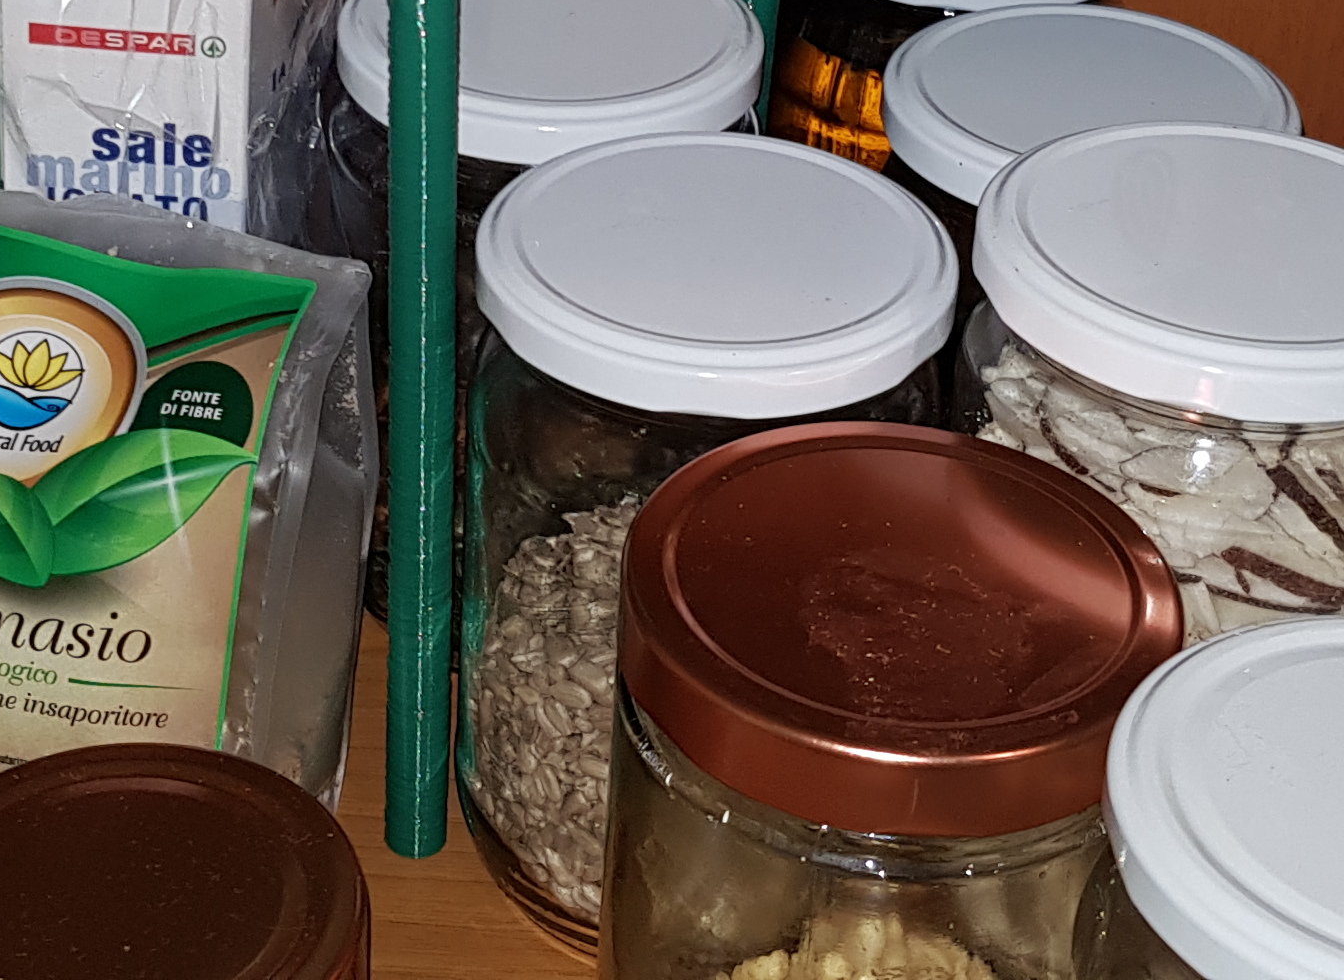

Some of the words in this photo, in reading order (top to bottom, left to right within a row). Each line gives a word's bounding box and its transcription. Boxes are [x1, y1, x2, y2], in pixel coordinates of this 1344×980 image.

[55, 26, 196, 54] DESPAR
[92, 122, 213, 168] sale
[26, 153, 232, 200] marino
[171, 388, 223, 406] FONTE
[159, 402, 177, 416] DI
[179, 403, 224, 421] FIBRE
[20, 433, 65, 454] Food
[22, 692, 170, 729] insaporitore
